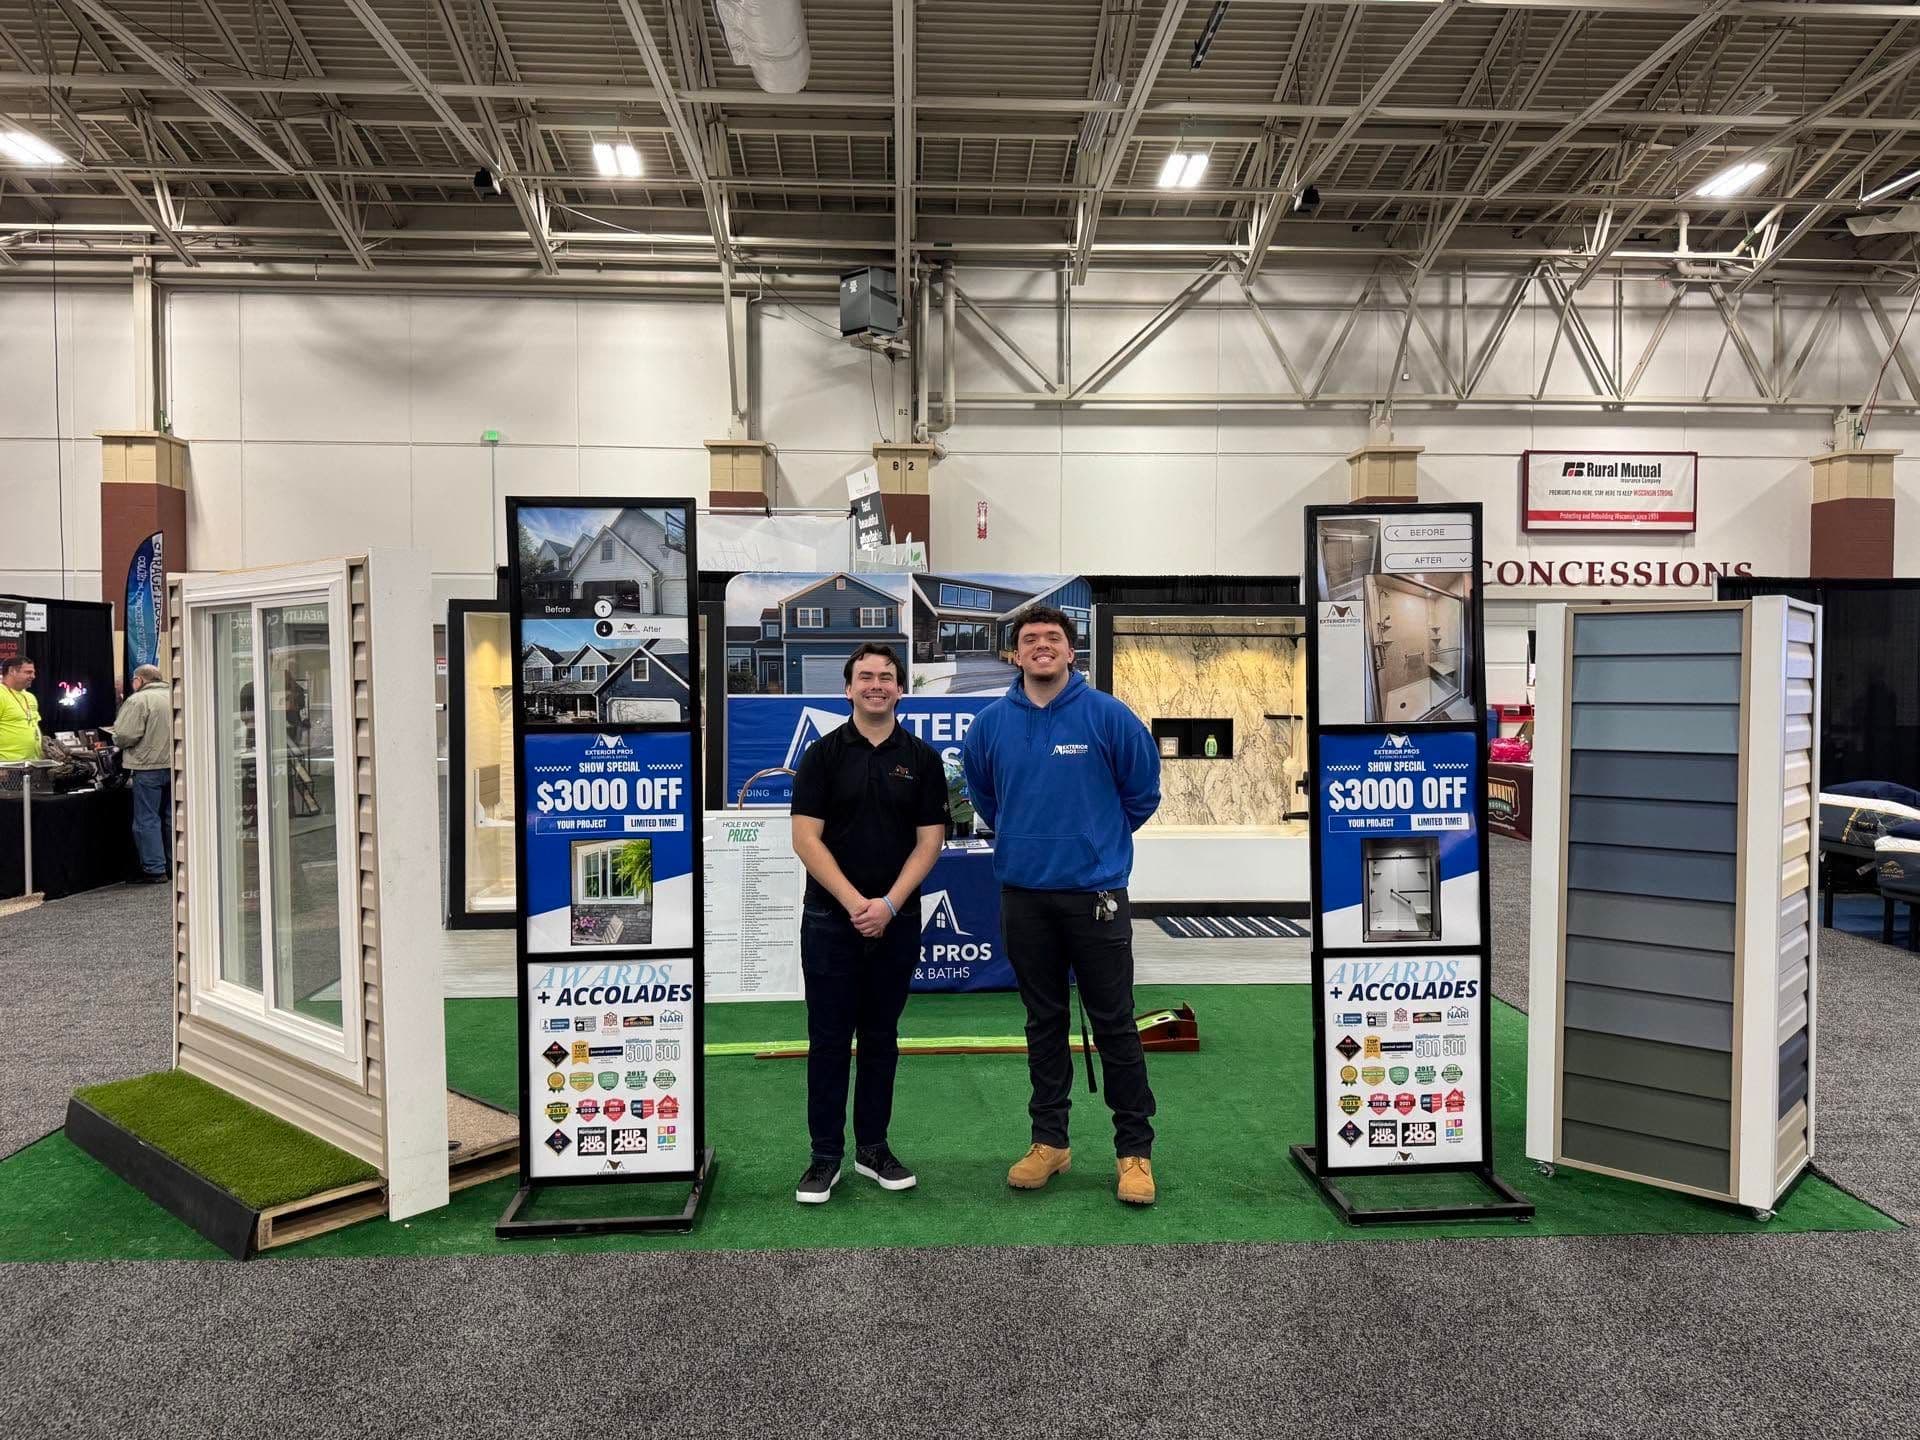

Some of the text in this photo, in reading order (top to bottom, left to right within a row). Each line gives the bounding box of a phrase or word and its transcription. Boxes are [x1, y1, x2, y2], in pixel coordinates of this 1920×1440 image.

[892, 462, 915, 471] B 2
[1587, 462, 1662, 478] Rural Mutual
[1410, 528, 1445, 537] BEFORE
[1414, 556, 1442, 565] AFTER
[545, 605, 571, 614] Before
[1319, 617, 1346, 625] EXTERIOR
[643, 625, 662, 633] After
[578, 761, 641, 773] SHOW SPECIAL
[1368, 761, 1427, 773] SHOW SPECIAL
[536, 777, 683, 814] $3000 OFF
[1328, 777, 1414, 813] $3000
[1422, 776, 1467, 809] OFF
[556, 819, 607, 830] YOUR PROJECT
[631, 818, 677, 828] LIMITED TIME!
[1348, 818, 1394, 828] YOUR PROJECT
[1417, 816, 1463, 827] LIMITED TIME!
[727, 828, 759, 842] PRIZES
[932, 943, 992, 962] PROS
[533, 964, 673, 990] AWARDS
[914, 966, 970, 980] & BATHS
[1326, 960, 1460, 984] AWARDS
[556, 984, 693, 1007] ACCOLADES
[1347, 980, 1478, 1002] ACCOLADES
[659, 1014, 684, 1023] NARI
[1447, 1011, 1470, 1019] NARI
[626, 1043, 653, 1062] 500
[656, 1043, 680, 1062] 500
[1415, 1039, 1440, 1058] 500
[1443, 1039, 1466, 1056] 500
[1409, 1123, 1430, 1132] HIP
[620, 1129, 641, 1139] HIP
[1371, 1134, 1396, 1144] 200
[1404, 1131, 1435, 1144] 200
[580, 1142, 605, 1152] 200
[614, 1137, 646, 1152] 200
